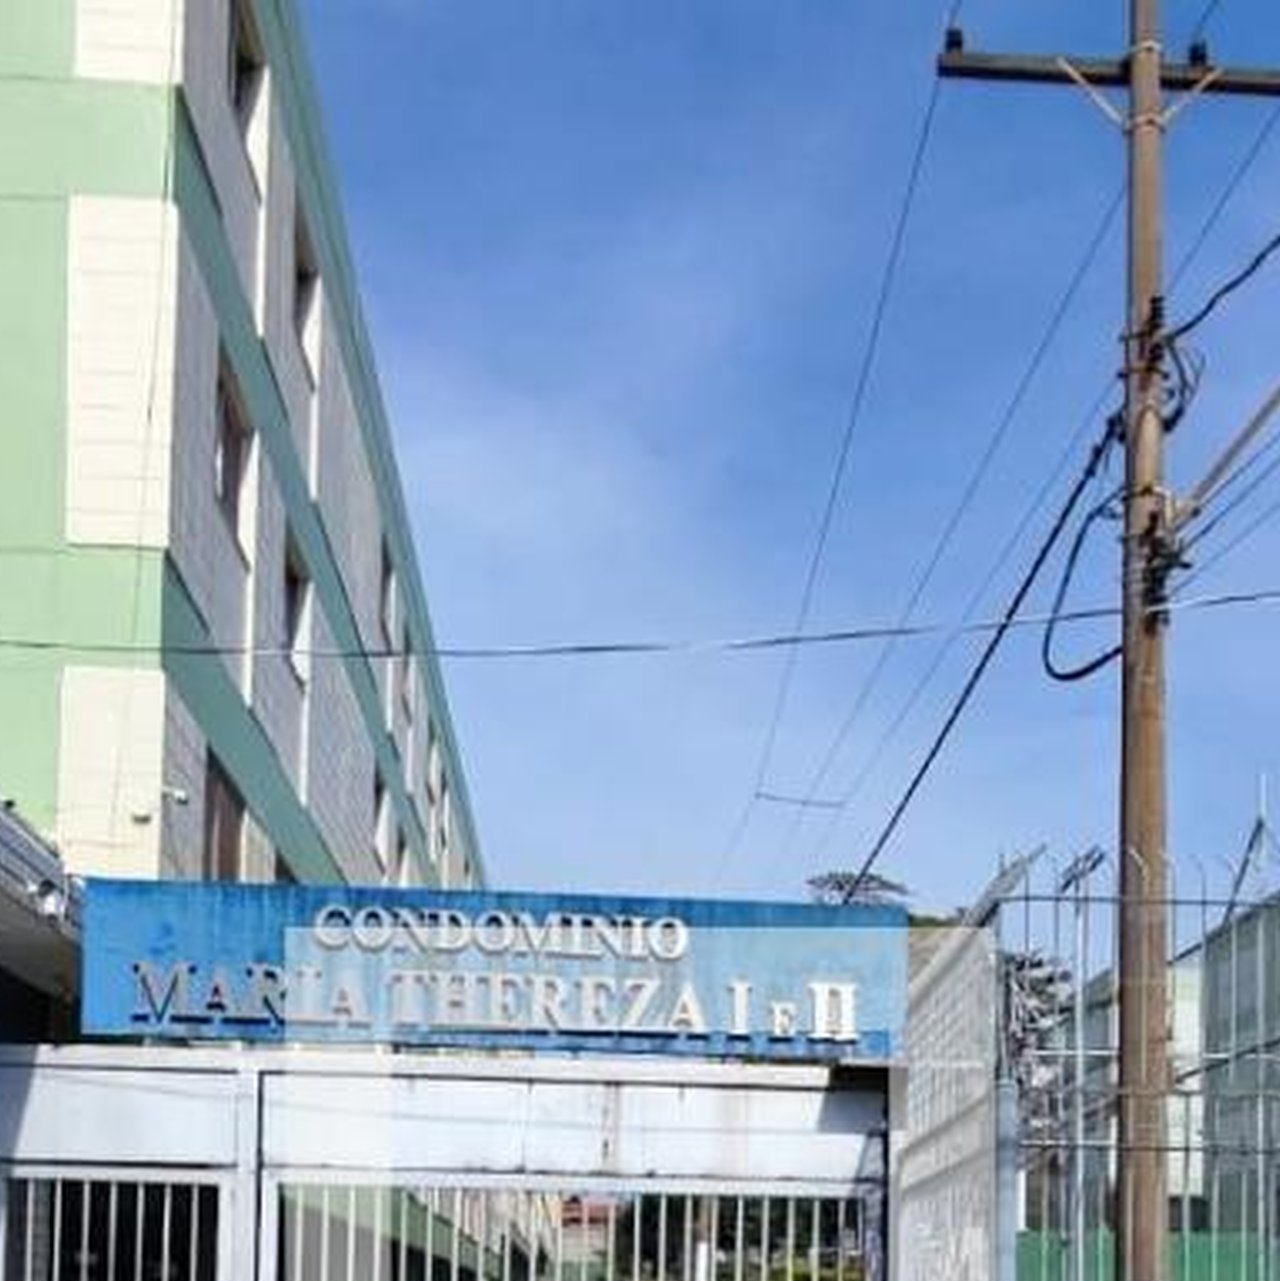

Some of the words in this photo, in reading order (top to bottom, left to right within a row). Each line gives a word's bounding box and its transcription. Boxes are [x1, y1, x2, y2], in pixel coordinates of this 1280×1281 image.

[315, 905, 689, 961] CONDOMINIO
[128, 961, 371, 1026] MARIA
[387, 971, 707, 1035] THEREZA
[727, 980, 752, 1036] I
[808, 982, 858, 1040] II
